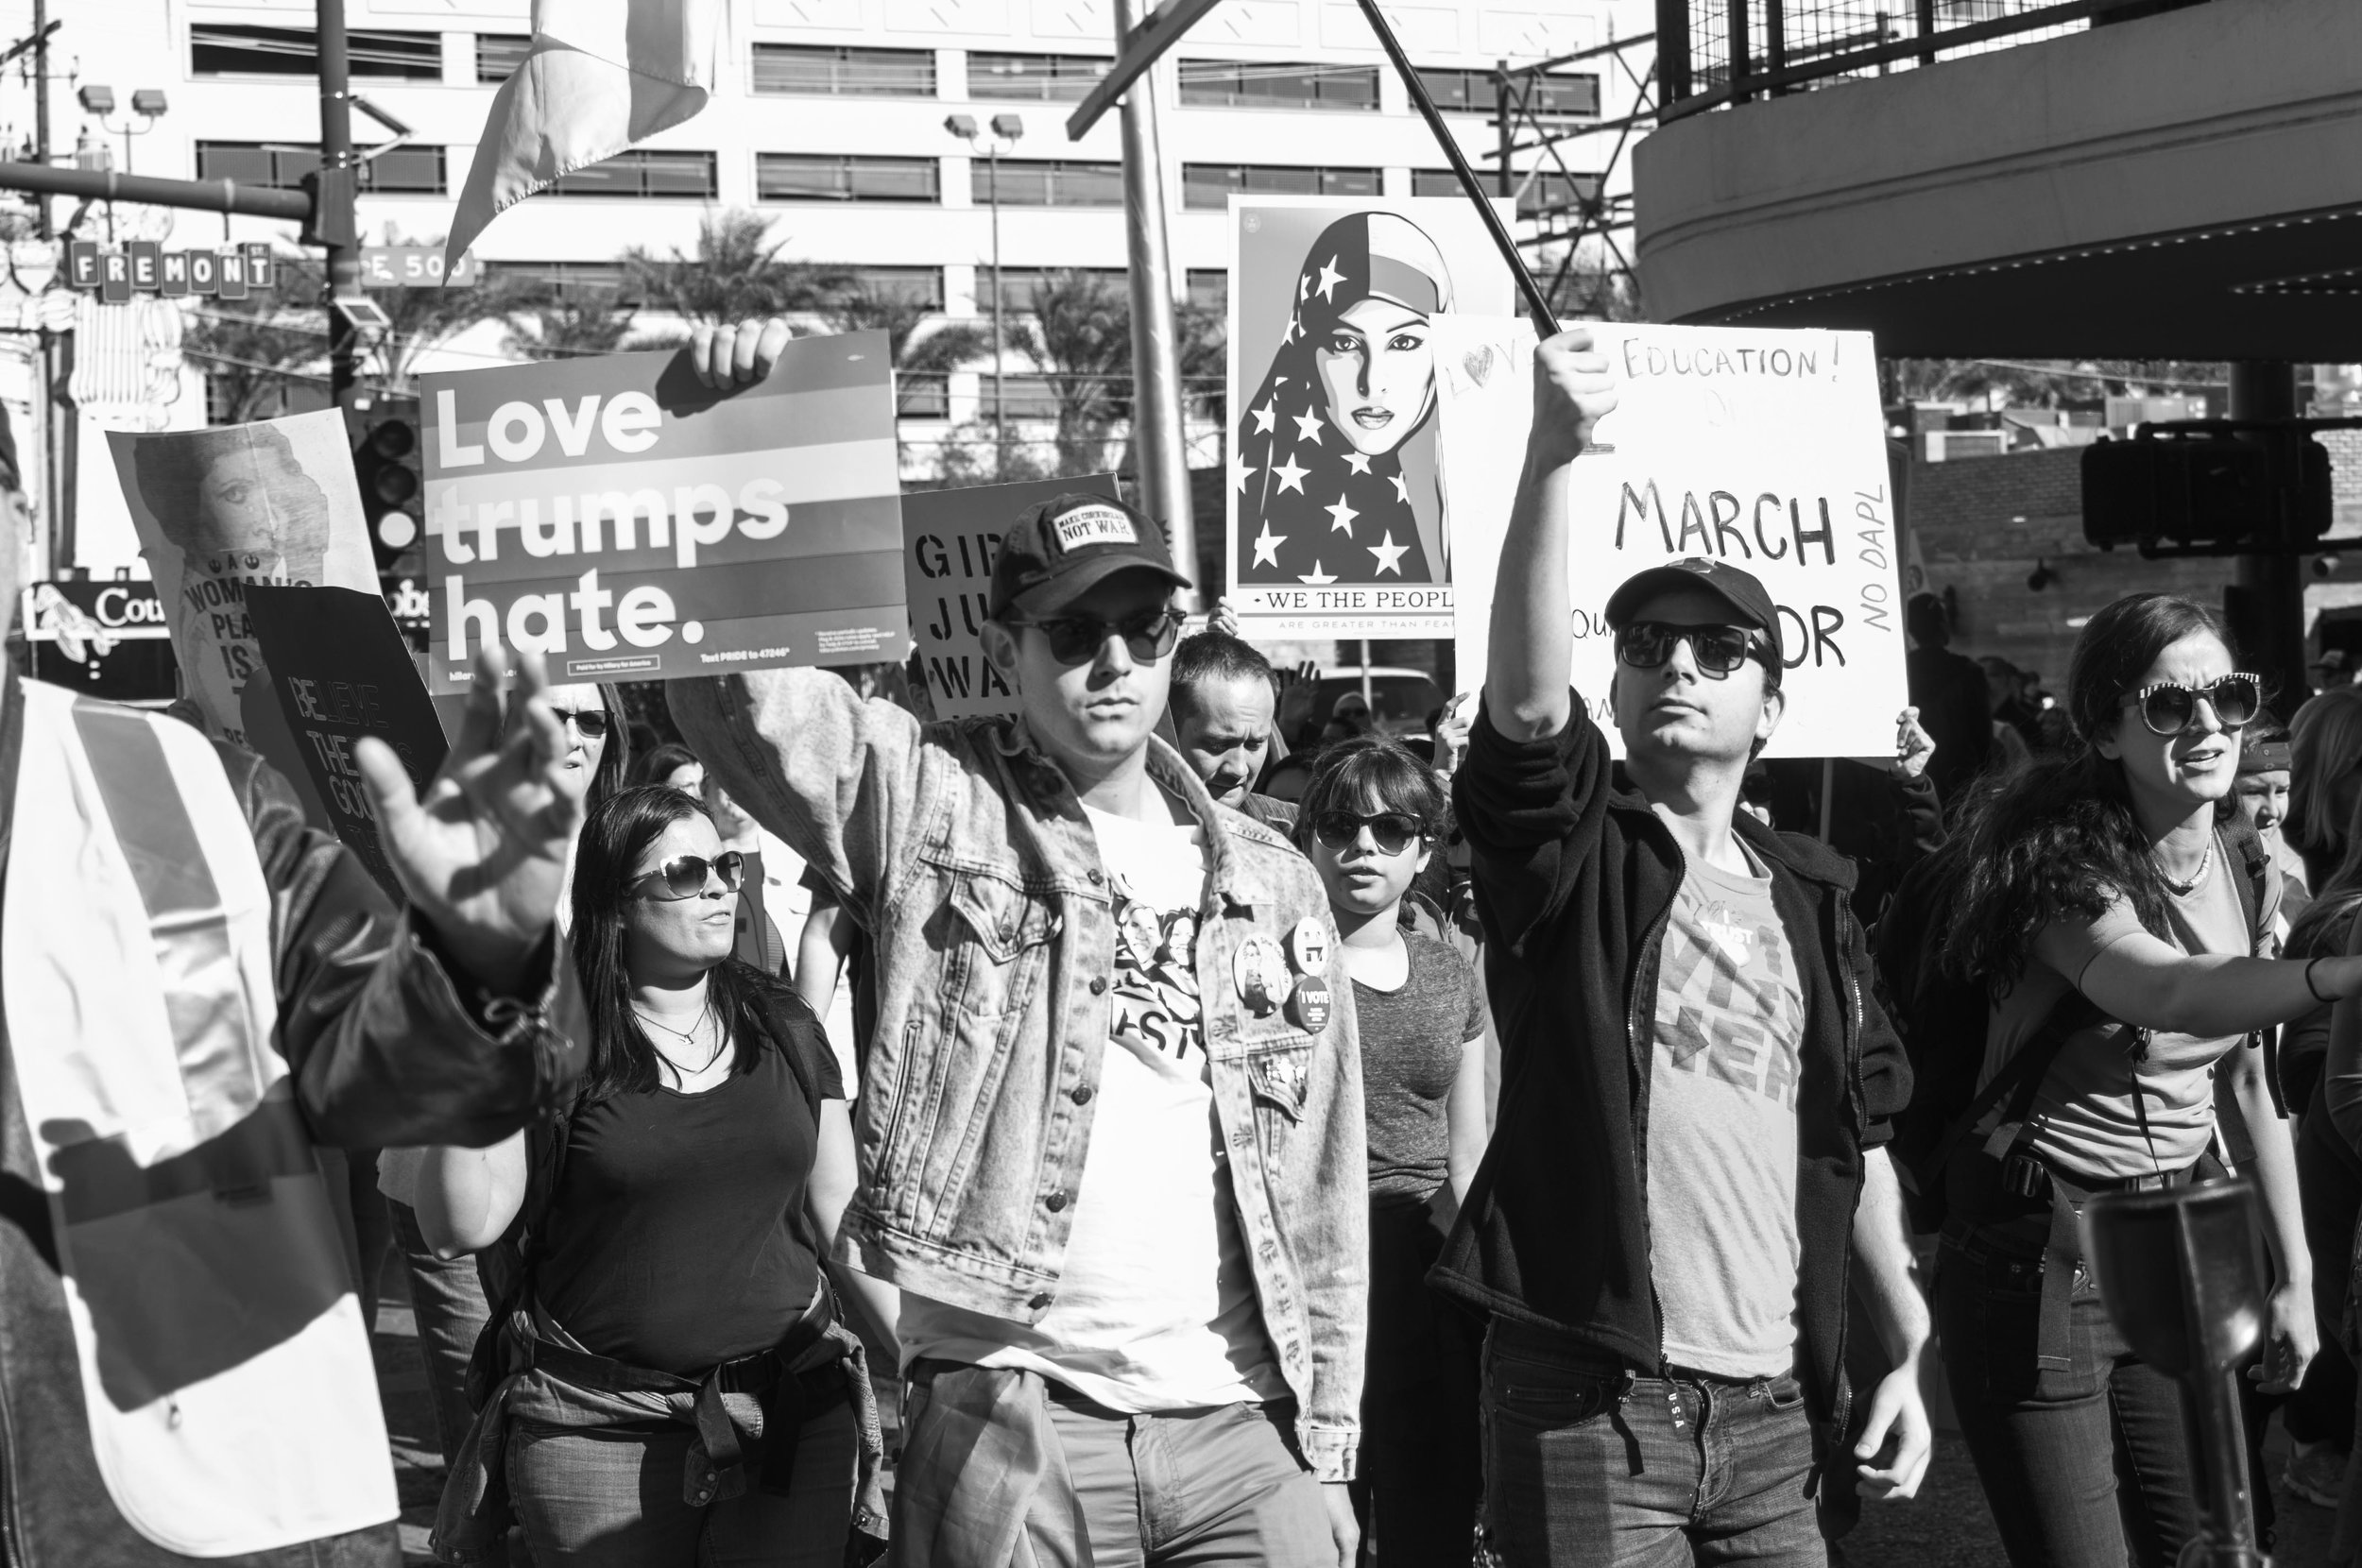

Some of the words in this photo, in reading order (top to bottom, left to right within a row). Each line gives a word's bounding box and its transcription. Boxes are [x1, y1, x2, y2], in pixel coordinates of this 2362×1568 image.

[77, 255, 268, 283] FREMONT
[371, 255, 388, 278] E
[436, 389, 661, 469] Love
[435, 478, 790, 568] trumps
[1063, 521, 1091, 542] NOT
[1095, 520, 1130, 536] WAR
[1615, 477, 1836, 566] MARCH
[1855, 484, 1888, 570] DAPL
[228, 554, 239, 570] A
[444, 568, 705, 661] hate.
[1267, 592, 1308, 609] WE
[1316, 591, 1366, 608] THE
[1861, 582, 1891, 632] NO
[1311, 621, 1375, 629] GREATER
[1381, 620, 1417, 628] THAN
[220, 644, 252, 681] IS
[1301, 991, 1307, 1004] I
[1307, 990, 1329, 1004] VOTE
